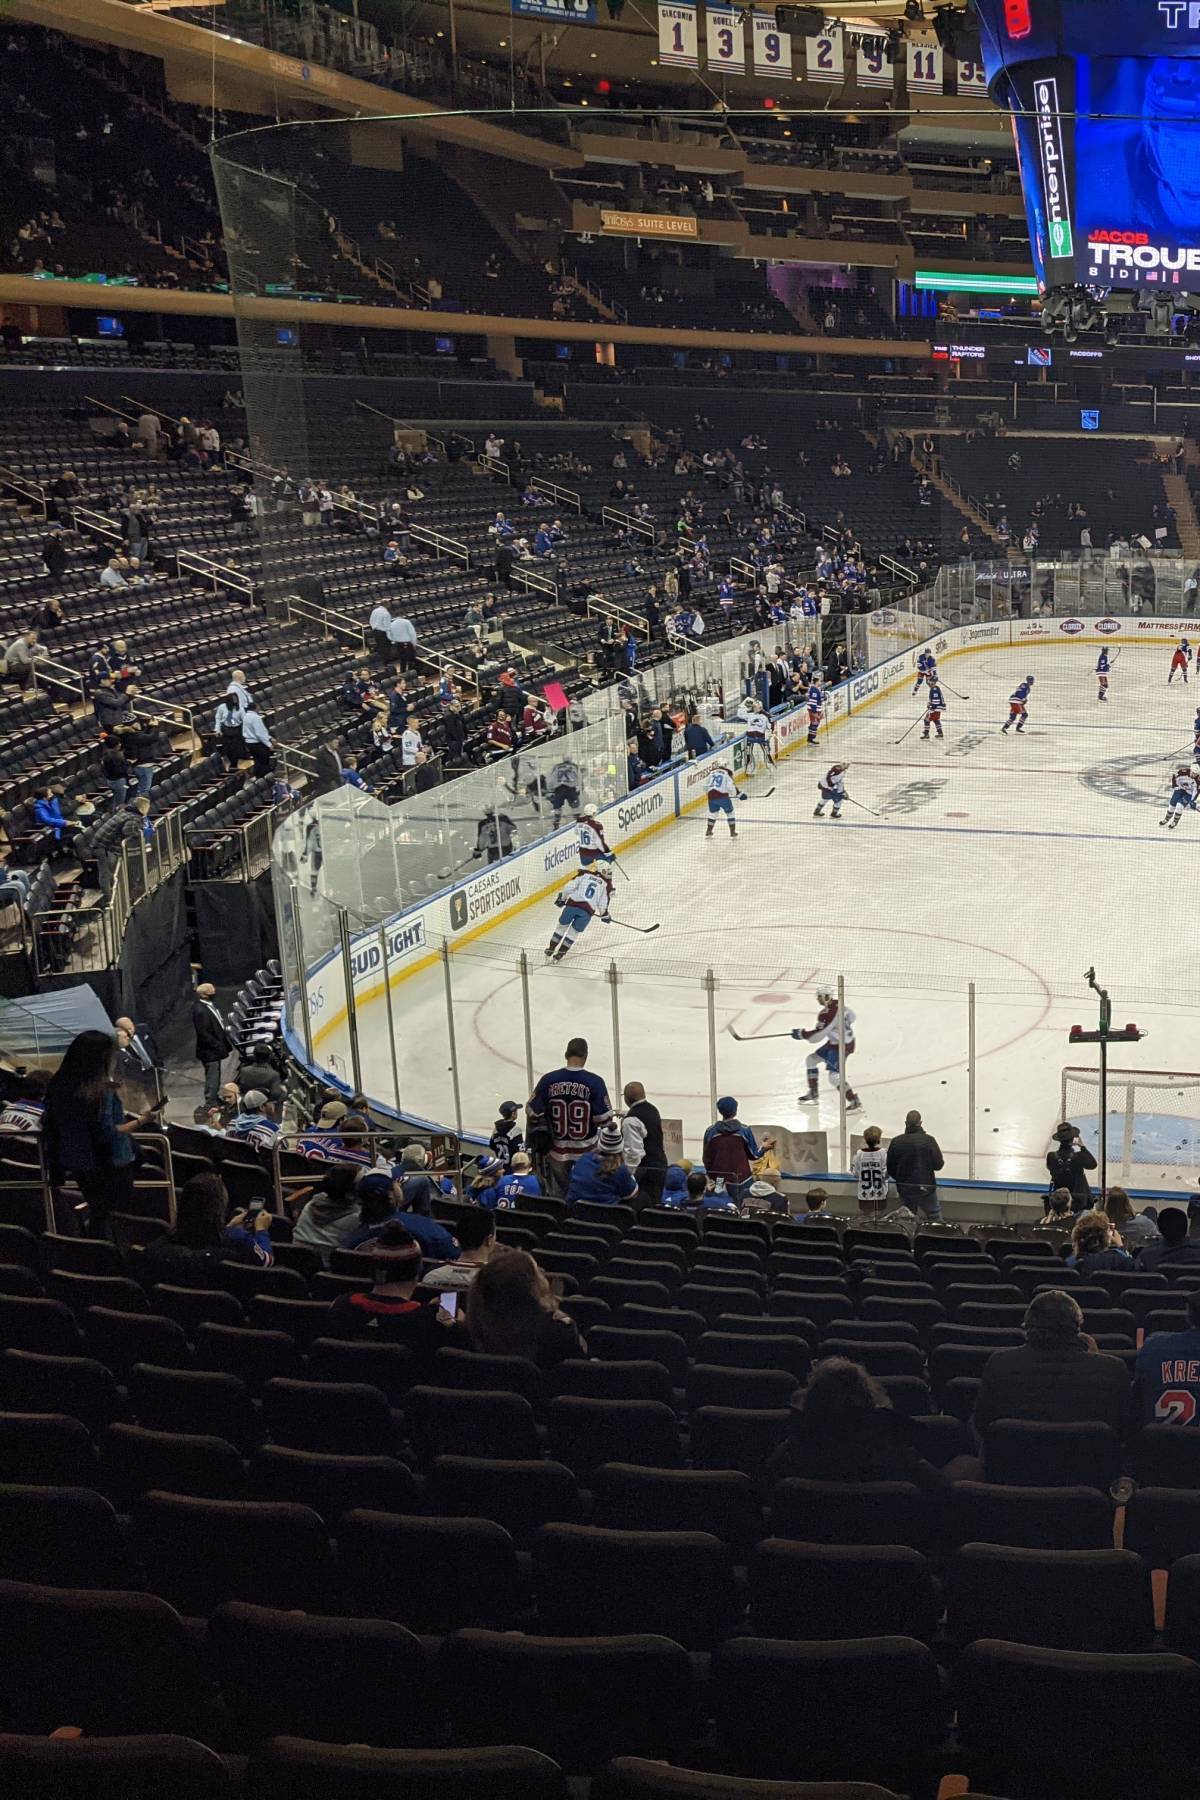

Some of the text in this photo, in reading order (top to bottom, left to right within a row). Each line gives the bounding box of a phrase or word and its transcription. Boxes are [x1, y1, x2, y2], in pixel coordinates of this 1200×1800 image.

[672, 22, 684, 52] 1
[718, 29, 733, 58] 3
[765, 33, 780, 63] 9
[817, 39, 833, 69] 2
[913, 51, 936, 80] 11
[1039, 84, 1064, 256] enterprise
[638, 218, 664, 230] SUITE
[666, 220, 694, 232] LEVEL
[1087, 229, 1149, 245] JACOB
[1089, 267, 1098, 276] 8
[853, 671, 879, 701] GEICO
[618, 792, 661, 832] Spectrum
[580, 830, 592, 845] 16
[544, 840, 580, 871] ticketma
[468, 872, 500, 898] CAESARS
[469, 876, 521, 921] SPORTSBOOK
[585, 882, 597, 899] 6
[350, 946, 380, 979] BUD
[549, 1099, 591, 1140] 99
[861, 1169, 882, 1190] 96
